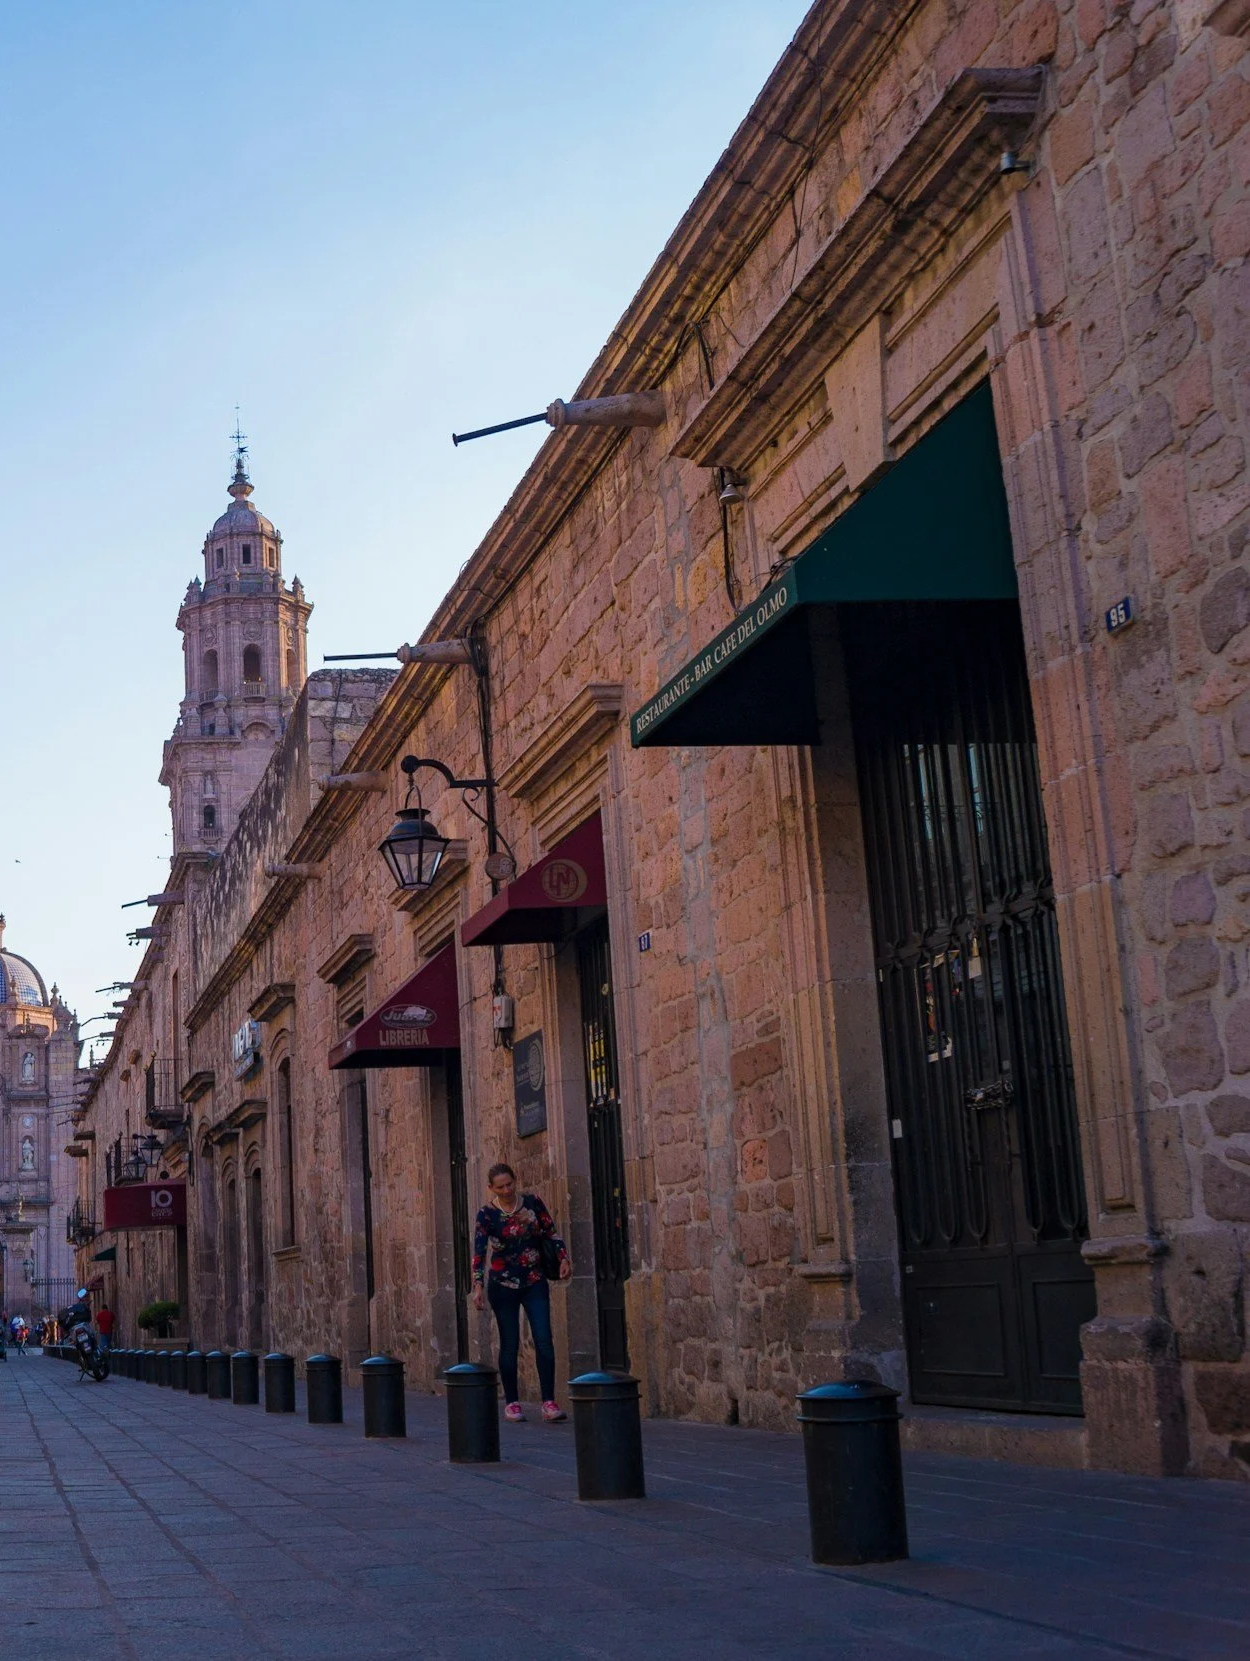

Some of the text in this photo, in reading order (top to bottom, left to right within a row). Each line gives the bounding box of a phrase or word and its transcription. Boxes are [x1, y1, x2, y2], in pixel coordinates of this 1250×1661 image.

[714, 632, 737, 664] CAFE
[737, 616, 757, 644] DEL
[756, 587, 788, 626] OLMO
[378, 1029, 430, 1046] LIBRERIA
